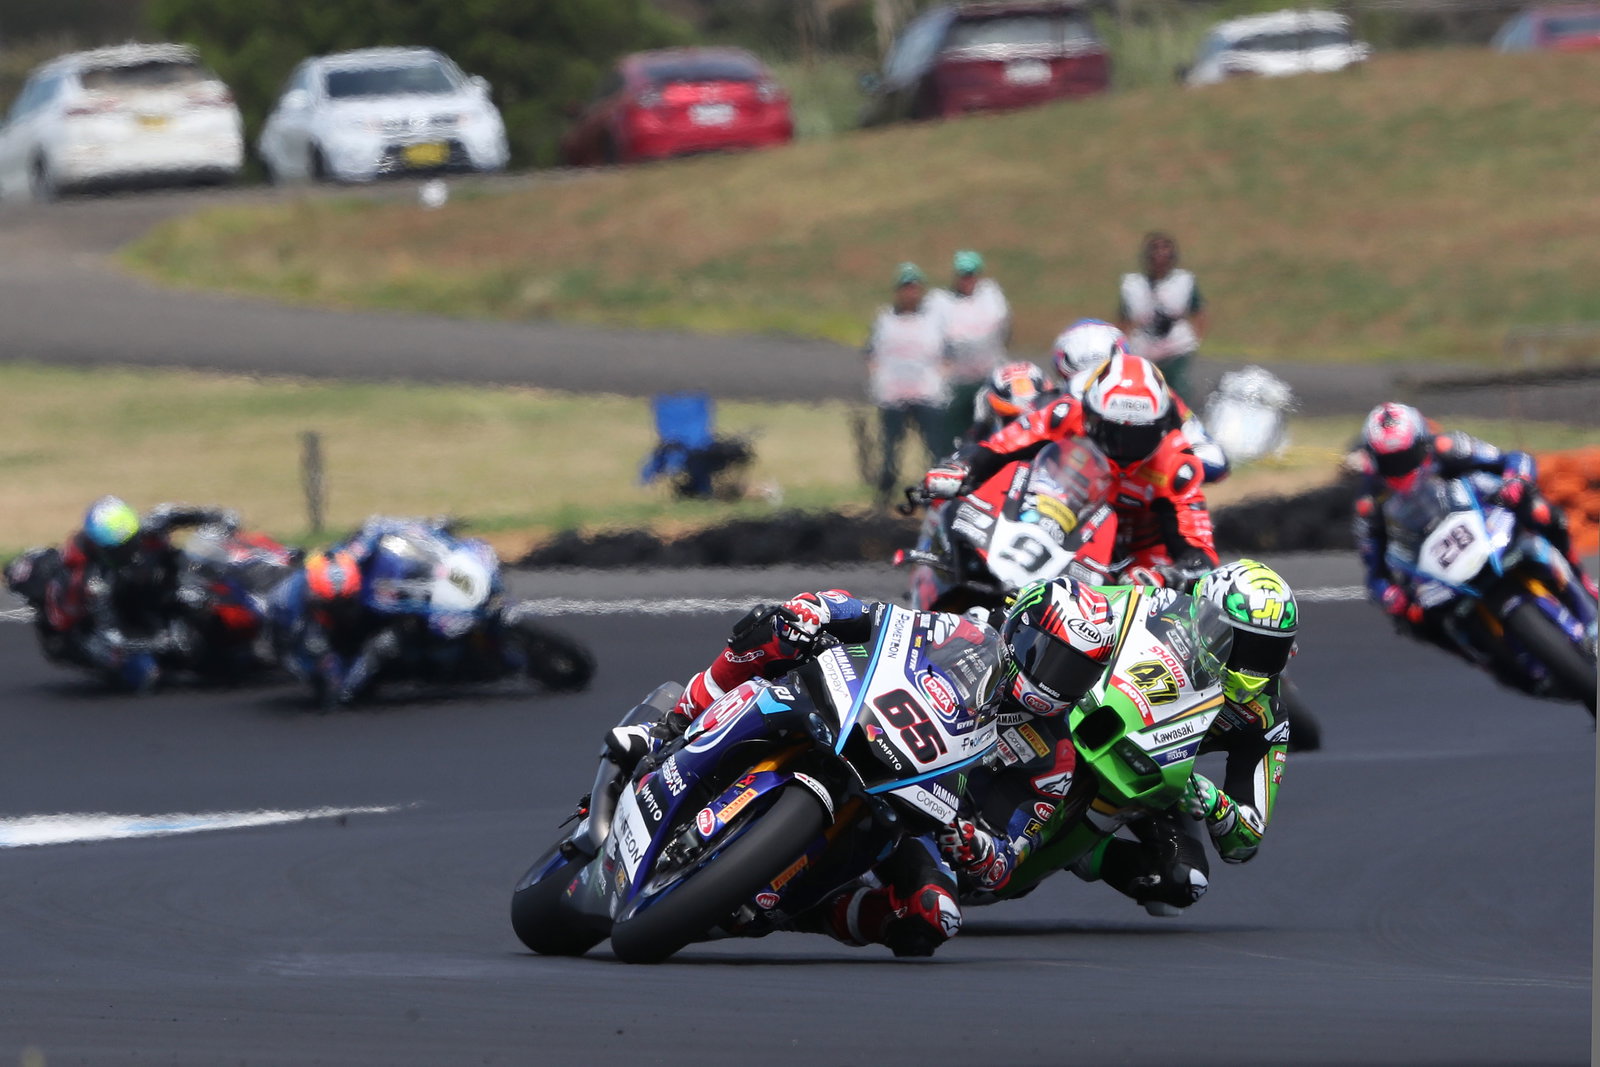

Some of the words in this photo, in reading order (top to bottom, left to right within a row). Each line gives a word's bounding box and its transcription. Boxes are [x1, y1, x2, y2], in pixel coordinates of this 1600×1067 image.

[1076, 620, 1100, 641] Arai
[821, 654, 846, 694] Corpay
[831, 645, 858, 682] YAMAHA
[1148, 645, 1187, 689] SHOWA
[925, 677, 951, 711] PATA
[1125, 660, 1180, 707] 47
[1118, 683, 1150, 719] MOTUL
[873, 688, 948, 764] 65
[996, 713, 1024, 725] AMAHA
[1152, 721, 1195, 745] Kawasaki
[876, 738, 902, 771] AMPITO
[915, 789, 952, 820] Corpay
[933, 783, 960, 811] YAMAHA
[698, 810, 709, 829] HEL
